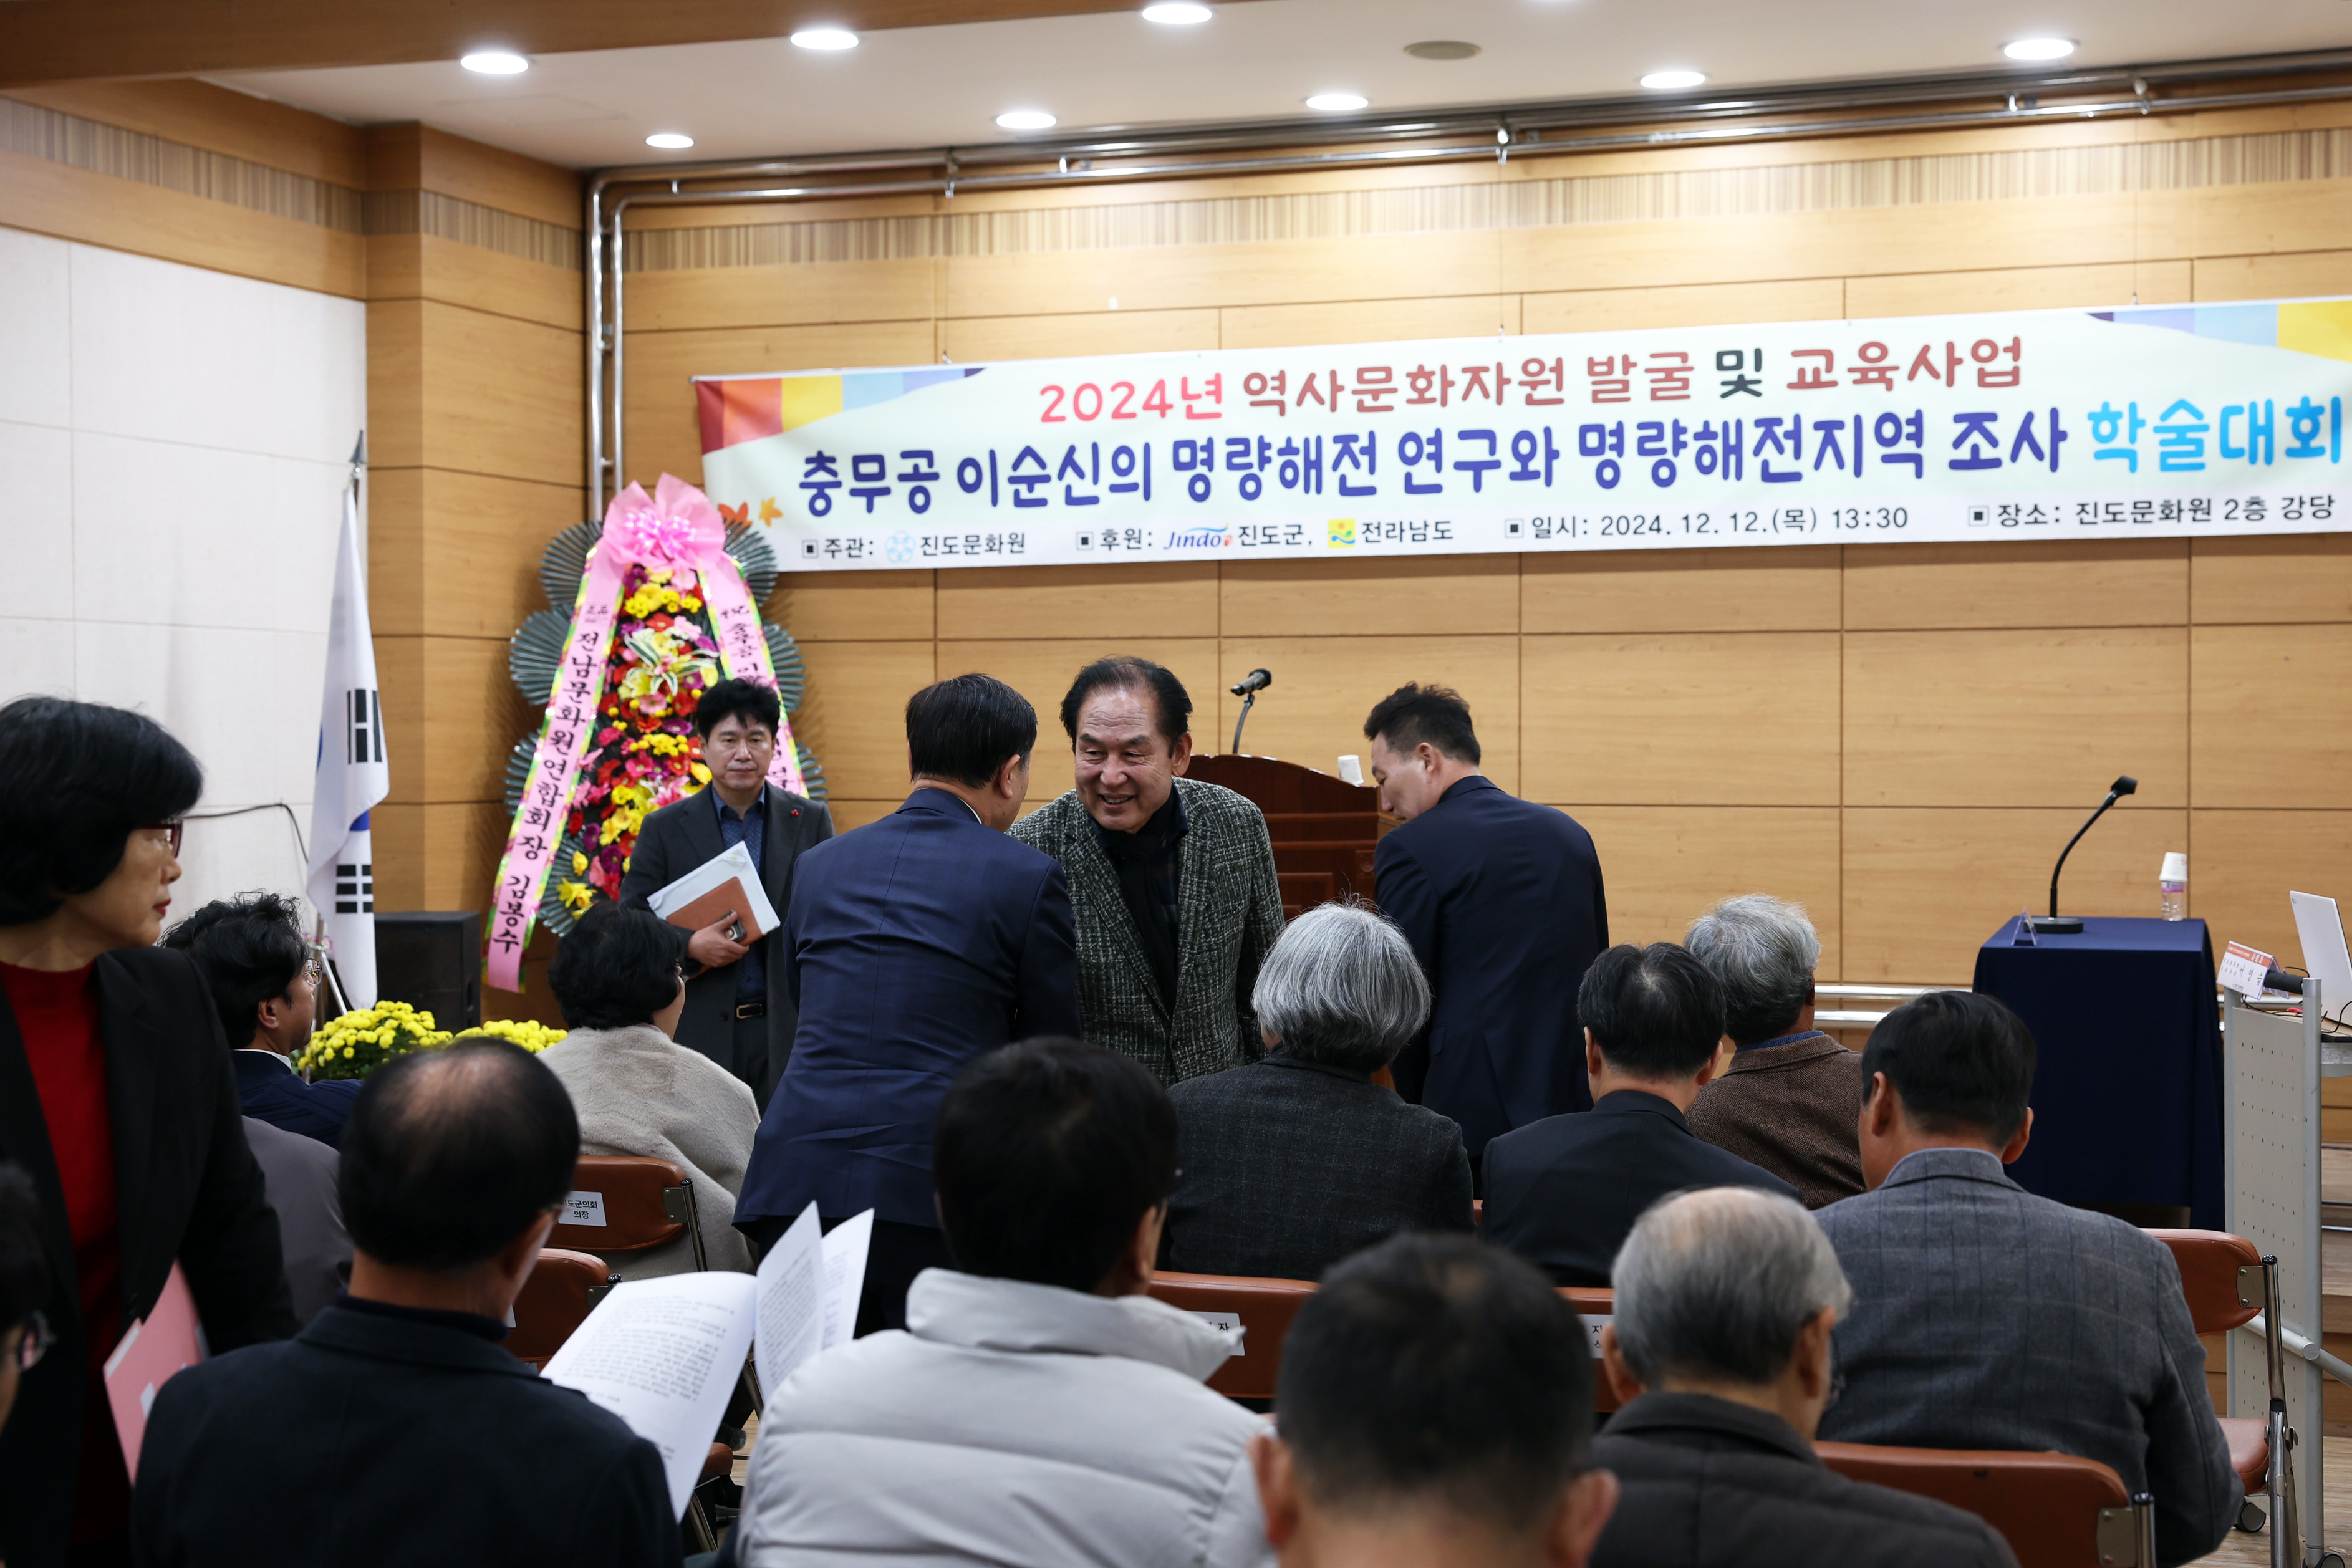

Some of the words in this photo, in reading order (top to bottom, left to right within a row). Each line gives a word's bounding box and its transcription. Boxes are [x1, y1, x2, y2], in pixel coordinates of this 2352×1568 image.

[1039, 372, 1222, 423] 2024년
[1243, 357, 1565, 417] 역사문화자원
[1587, 352, 1694, 404] 발굴
[1715, 347, 1763, 399] 및
[1786, 336, 2021, 392] 교육사업
[799, 449, 940, 517] 충무공
[956, 441, 1152, 509] 이순신의
[1172, 430, 1377, 503] 명량해전
[1397, 426, 1561, 495] 연구와
[1578, 408, 1924, 490] 명량해전지역
[1948, 406, 2068, 473] 조사
[2087, 395, 2343, 474] 학술대회
[1531, 516, 1588, 539] 일시:
[1832, 507, 1908, 529] 13:30
[1998, 503, 2060, 527] 장소:
[2076, 498, 2212, 525] 진도문화원
[2224, 496, 2267, 522] 2층
[2282, 494, 2335, 521] 강당
[824, 537, 874, 559] 주관:
[920, 532, 1024, 557] 진도문화원
[1100, 528, 1152, 551] 후원:
[1164, 531, 1222, 550] Jindo
[1238, 524, 1312, 547] 진도군,
[1362, 520, 1453, 543] 전라남도
[493, 875, 530, 955] 김봉수
[564, 1199, 598, 1210] 도군의회
[574, 1210, 589, 1219] 의장
